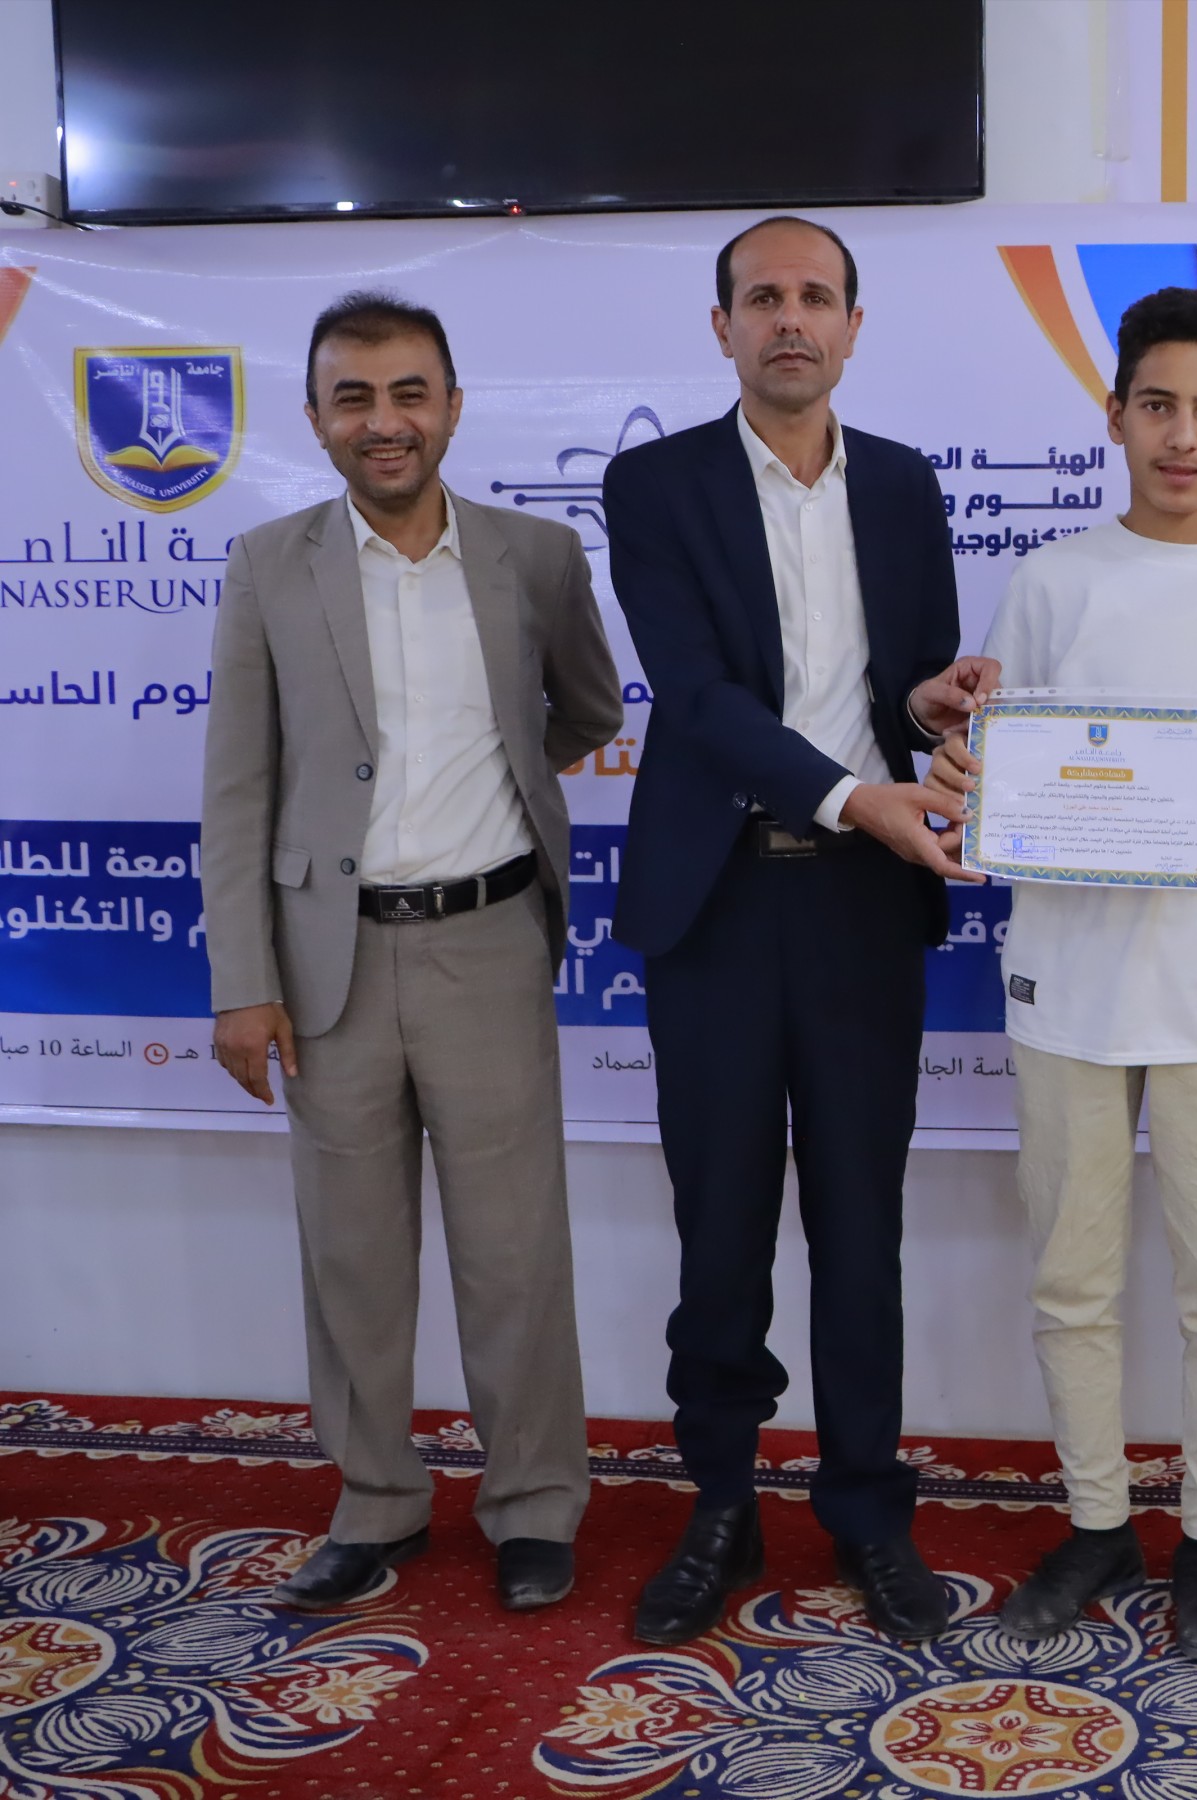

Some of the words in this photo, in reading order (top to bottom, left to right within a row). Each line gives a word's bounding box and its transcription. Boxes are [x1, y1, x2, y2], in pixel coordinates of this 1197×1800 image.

[186, 361, 225, 378] جامعة
[971, 446, 1105, 476] الهيئة
[159, 466, 209, 497] UNIVERSITY
[965, 486, 1103, 519] للعلوم
[0, 579, 184, 614] NASSER
[0, 670, 115, 704] الحاس
[133, 670, 212, 720] لوم
[0, 895, 173, 942] والتكنلو
[0, 1036, 29, 1060] صبا
[39, 1039, 62, 1056] 10
[71, 1037, 132, 1058] الساعة
